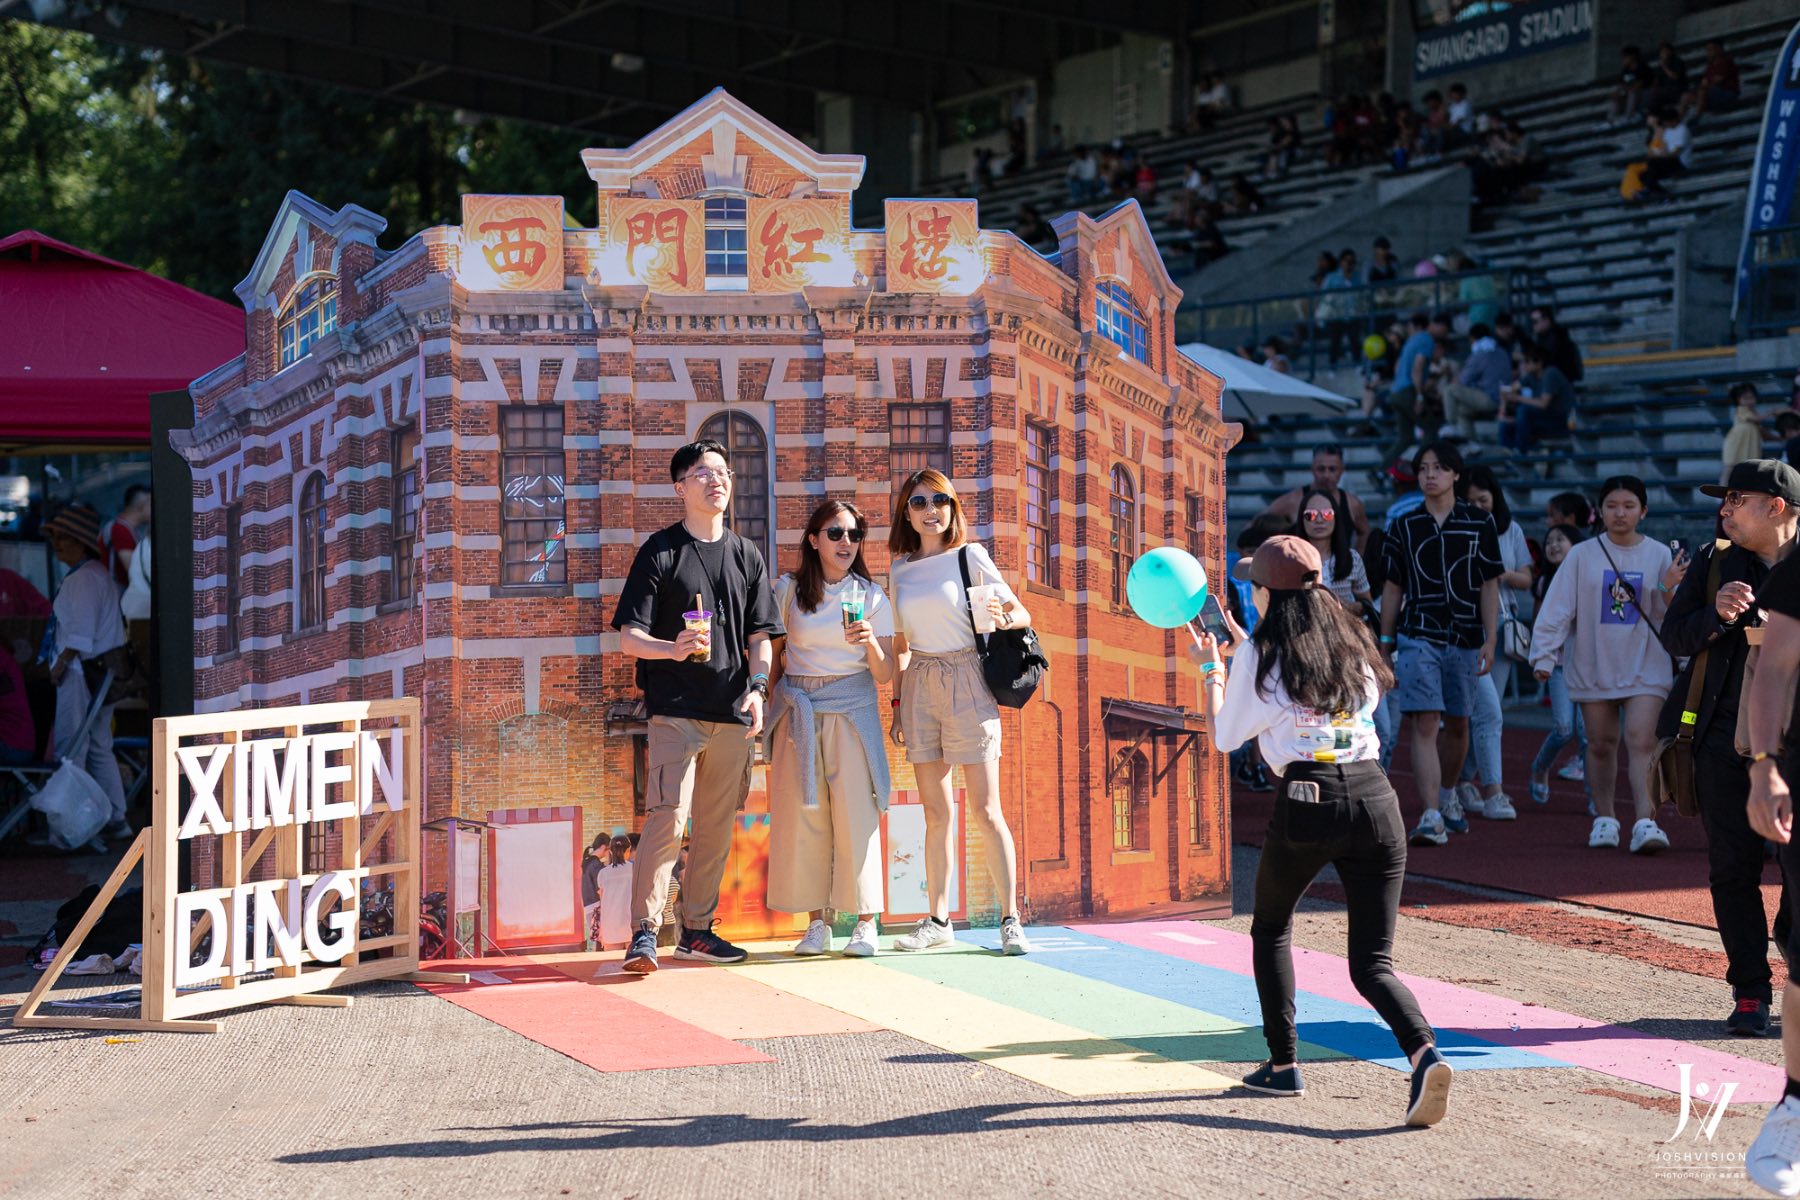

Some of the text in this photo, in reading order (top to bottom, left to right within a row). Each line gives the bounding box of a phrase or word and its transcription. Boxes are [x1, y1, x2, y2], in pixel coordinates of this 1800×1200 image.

[1416, 22, 1510, 72] SWANGARD
[1760, 99, 1795, 229] WASHRO
[175, 728, 403, 840] XIMEN
[173, 872, 355, 987] DING
